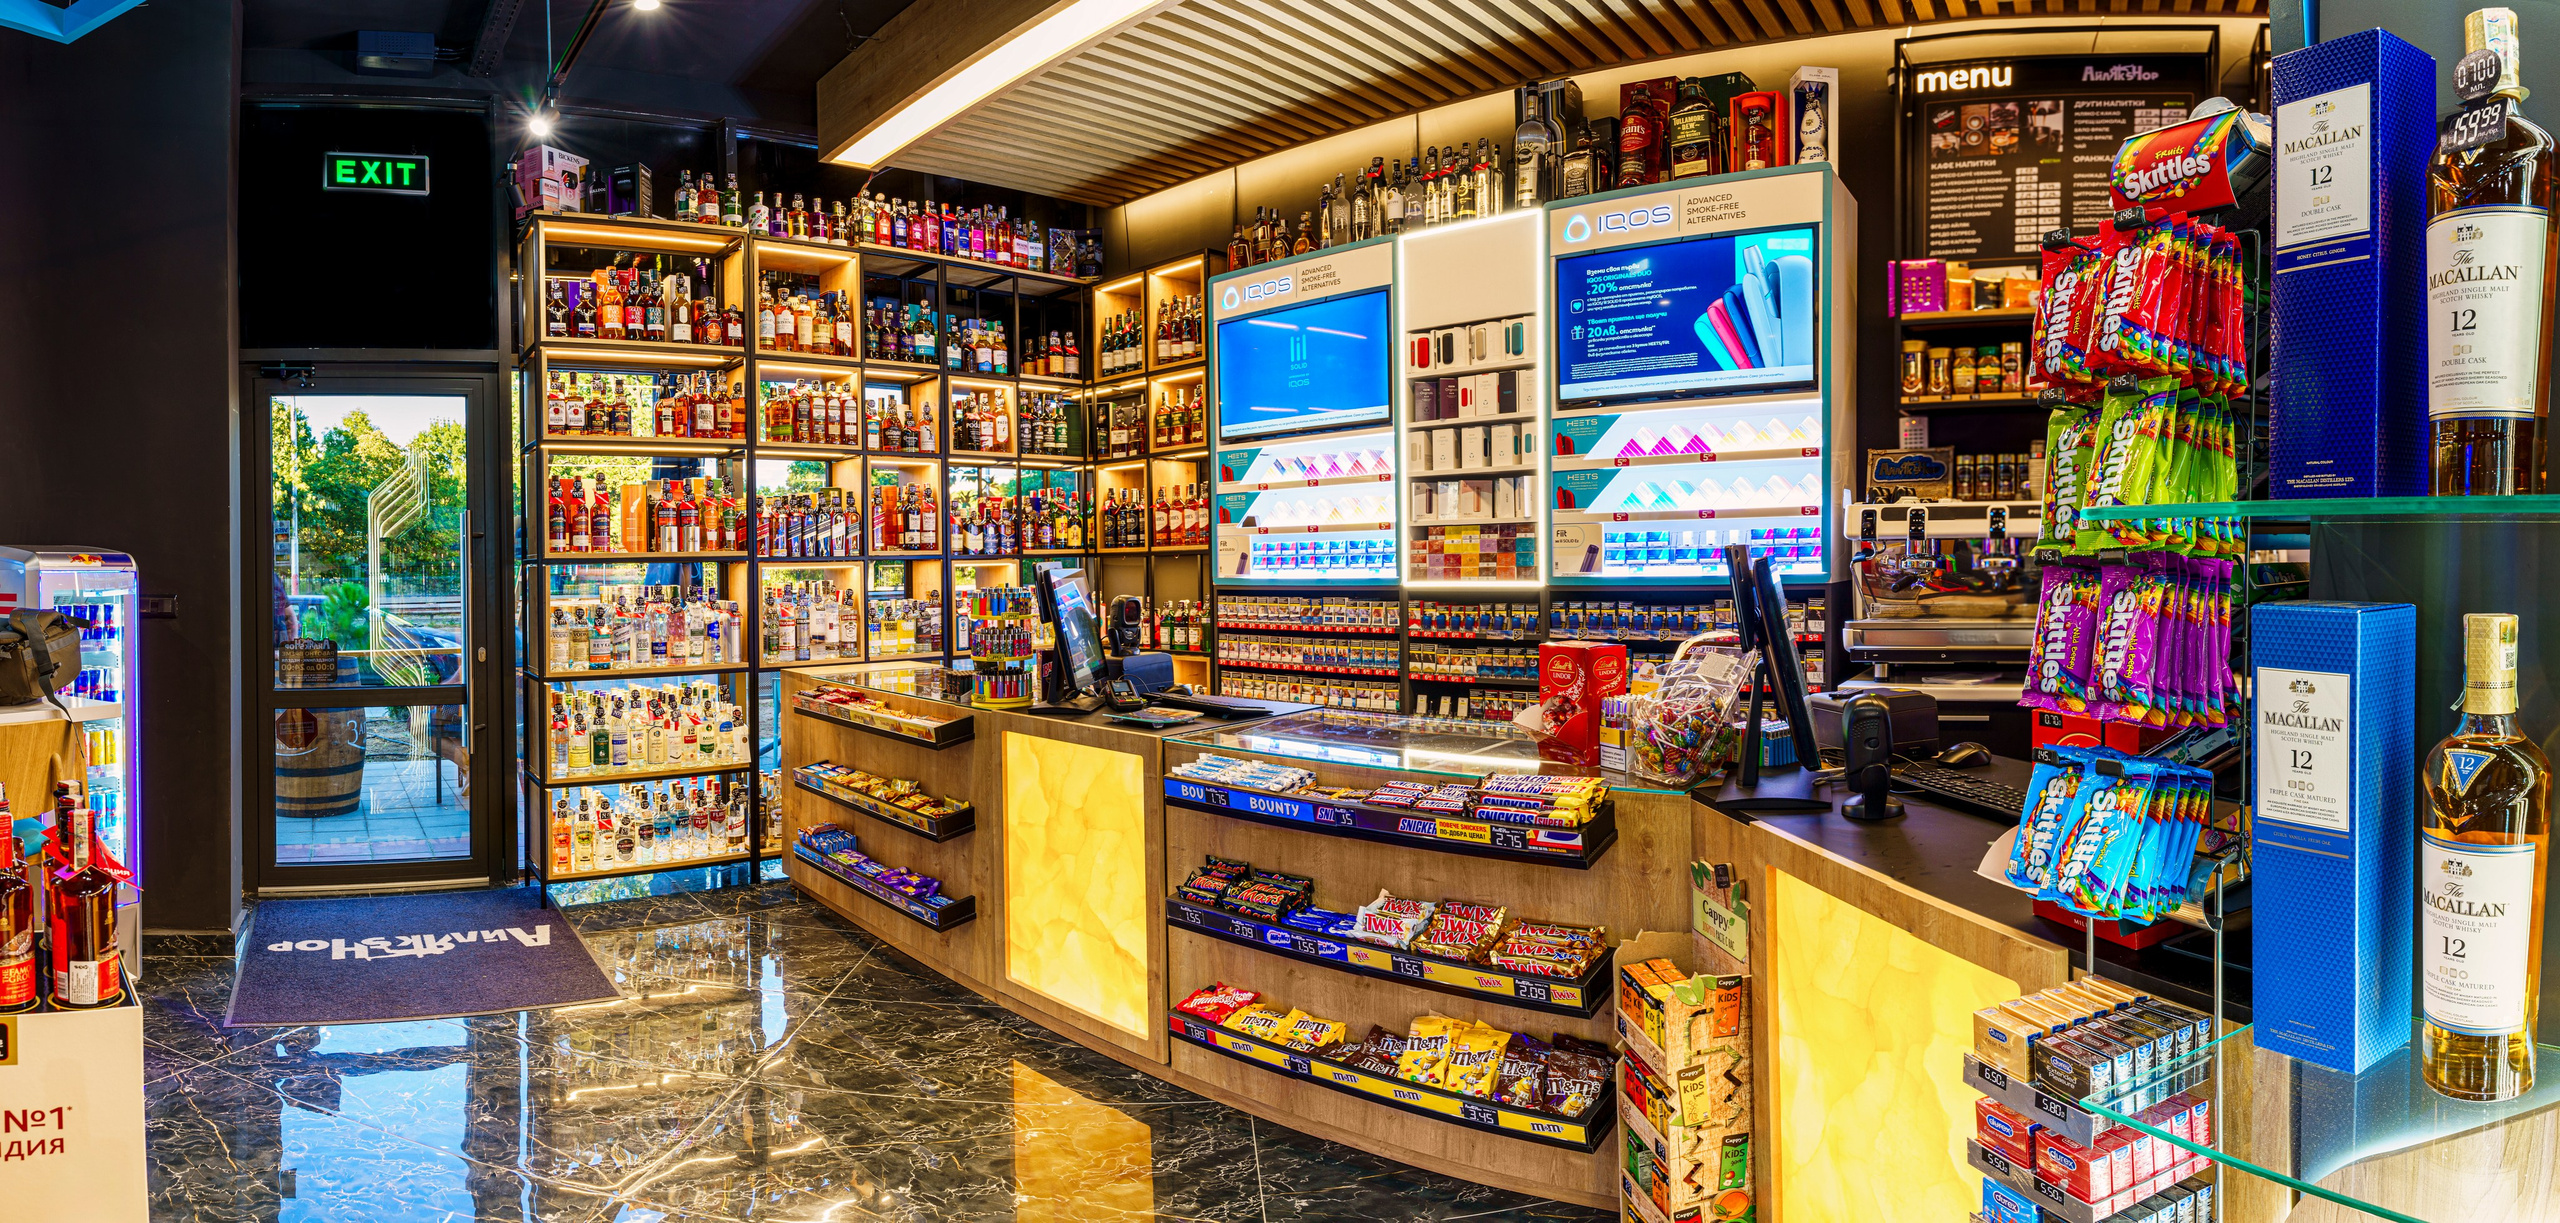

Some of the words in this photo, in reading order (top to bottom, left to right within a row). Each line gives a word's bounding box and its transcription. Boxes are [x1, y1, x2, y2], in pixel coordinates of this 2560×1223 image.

[2458, 55, 2496, 88] 0.700
[1917, 66, 2012, 94] menu
[1673, 115, 1704, 126] TULLAMORE
[2311, 119, 2329, 135] The
[2284, 125, 2362, 155] MACALLAN
[2290, 151, 2318, 162] HIGHLAND
[2319, 147, 2339, 156] SINGLE
[2340, 143, 2355, 152] MALT
[2300, 156, 2322, 165] SCOTCH
[2323, 151, 2344, 161] WHISKY
[336, 160, 416, 185] EXIT
[1931, 162, 1954, 170] КАФЕ
[2124, 154, 2212, 200] Skittles
[2310, 165, 2332, 187] 12
[1687, 193, 1733, 206] ADVANCED
[1687, 202, 1739, 215] SMOKE-FREE
[2301, 208, 2324, 217] DOUBLE
[2326, 204, 2341, 213] CASK
[1598, 205, 1672, 232] IQOS
[1687, 211, 1746, 225] ALTERNATIVES
[2451, 249, 2474, 267] The
[1301, 264, 1332, 276] ADVANCED
[1587, 268, 1605, 276] Вземи
[1603, 272, 1637, 281] ORIGINALS
[1301, 272, 1337, 285] SMOKE-FREE
[1301, 279, 1341, 292] ALTERNATIVES
[2429, 265, 2518, 291] MACALLAN
[1243, 277, 1292, 301] IQOS
[1591, 282, 1617, 294] 20%
[2100, 246, 2142, 352] Skittles
[2440, 295, 2463, 304] SCOTCH
[1646, 312, 1667, 320] получи
[2045, 272, 2078, 374] Skittles
[2451, 309, 2477, 331] 12
[1290, 335, 1307, 362] lil
[1290, 362, 1308, 371] SOLID
[2442, 358, 2466, 367] DOUBLE
[1288, 378, 1310, 388] IQOS
[1567, 418, 1598, 427] HEETS
[1567, 473, 1598, 481] HEETS
[2054, 431, 2078, 540] Skittles
[2040, 586, 2074, 694] Skittles
[2102, 590, 2136, 702] Skittles
[1553, 672, 1571, 680] LINDOR
[2291, 700, 2310, 714] The
[2264, 710, 2341, 732] MACALLAN
[2270, 729, 2298, 737] HIGHLAND
[2300, 732, 2319, 740] SINGLE
[2291, 749, 2313, 770] 12
[2459, 756, 2474, 772] 12
[2269, 788, 2288, 796] TRIPLE
[2290, 791, 2305, 799] CASK
[2306, 795, 2336, 804] MATURED
[1250, 797, 1299, 817] BOUNTY
[1477, 810, 1534, 824] SNICKERS
[1538, 817, 1564, 826] SUPER
[1439, 822, 1459, 830] ПОВЕЧЕ
[2026, 778, 2066, 884] Skittles
[1440, 829, 1468, 837] ПО-ДОБРА
[1469, 832, 1486, 840] ЦЕНА!
[1496, 833, 1521, 848] 2.75
[2058, 790, 2117, 894] Skittles
[1191, 877, 1225, 890] Mars
[2442, 882, 2464, 898] The
[1238, 889, 1283, 905] Mars
[2424, 887, 2506, 917] MACALLAN
[1446, 902, 1495, 922] Twix
[1703, 900, 1728, 931] Cappy
[1365, 913, 1404, 932] Twix
[1440, 914, 1488, 935] Twix
[2432, 919, 2453, 930] SCOTCH
[2456, 925, 2482, 933] WHISKY
[2452, 918, 2476, 927] SINGLE
[1235, 925, 1253, 938] 2.09
[1432, 930, 1481, 945] Twix
[1298, 940, 1315, 953] 1.55
[1507, 943, 1557, 955] Twix
[2442, 936, 2466, 958] 12
[1400, 963, 1420, 976] 1.55
[1476, 976, 1503, 987] Twix
[2441, 976, 2456, 986] CASK
[2459, 981, 2495, 990] MATURED
[1520, 985, 1546, 1000] 2.09
[1551, 989, 1578, 1000] Twix
[1989, 1029, 2008, 1042] durex
[2052, 1057, 2072, 1072] durex
[1681, 1070, 1699, 1078] Cappy
[1984, 1066, 2001, 1085] 6.50
[2046, 1066, 2077, 1084] Extended
[2048, 1072, 2075, 1088] Pleasure
[2042, 1098, 2062, 1118] 5.80
[1469, 1109, 1494, 1124] 3.45
[1987, 1115, 2012, 1135] durex
[0, 1138, 64, 1162] ДИЯ
[1987, 1153, 2005, 1172] 5.50
[2049, 1149, 2076, 1169] durex
[2040, 1178, 2060, 1199] 5.50
[1994, 1192, 2018, 1212] durex
[1676, 1211, 1694, 1219] Cappy
